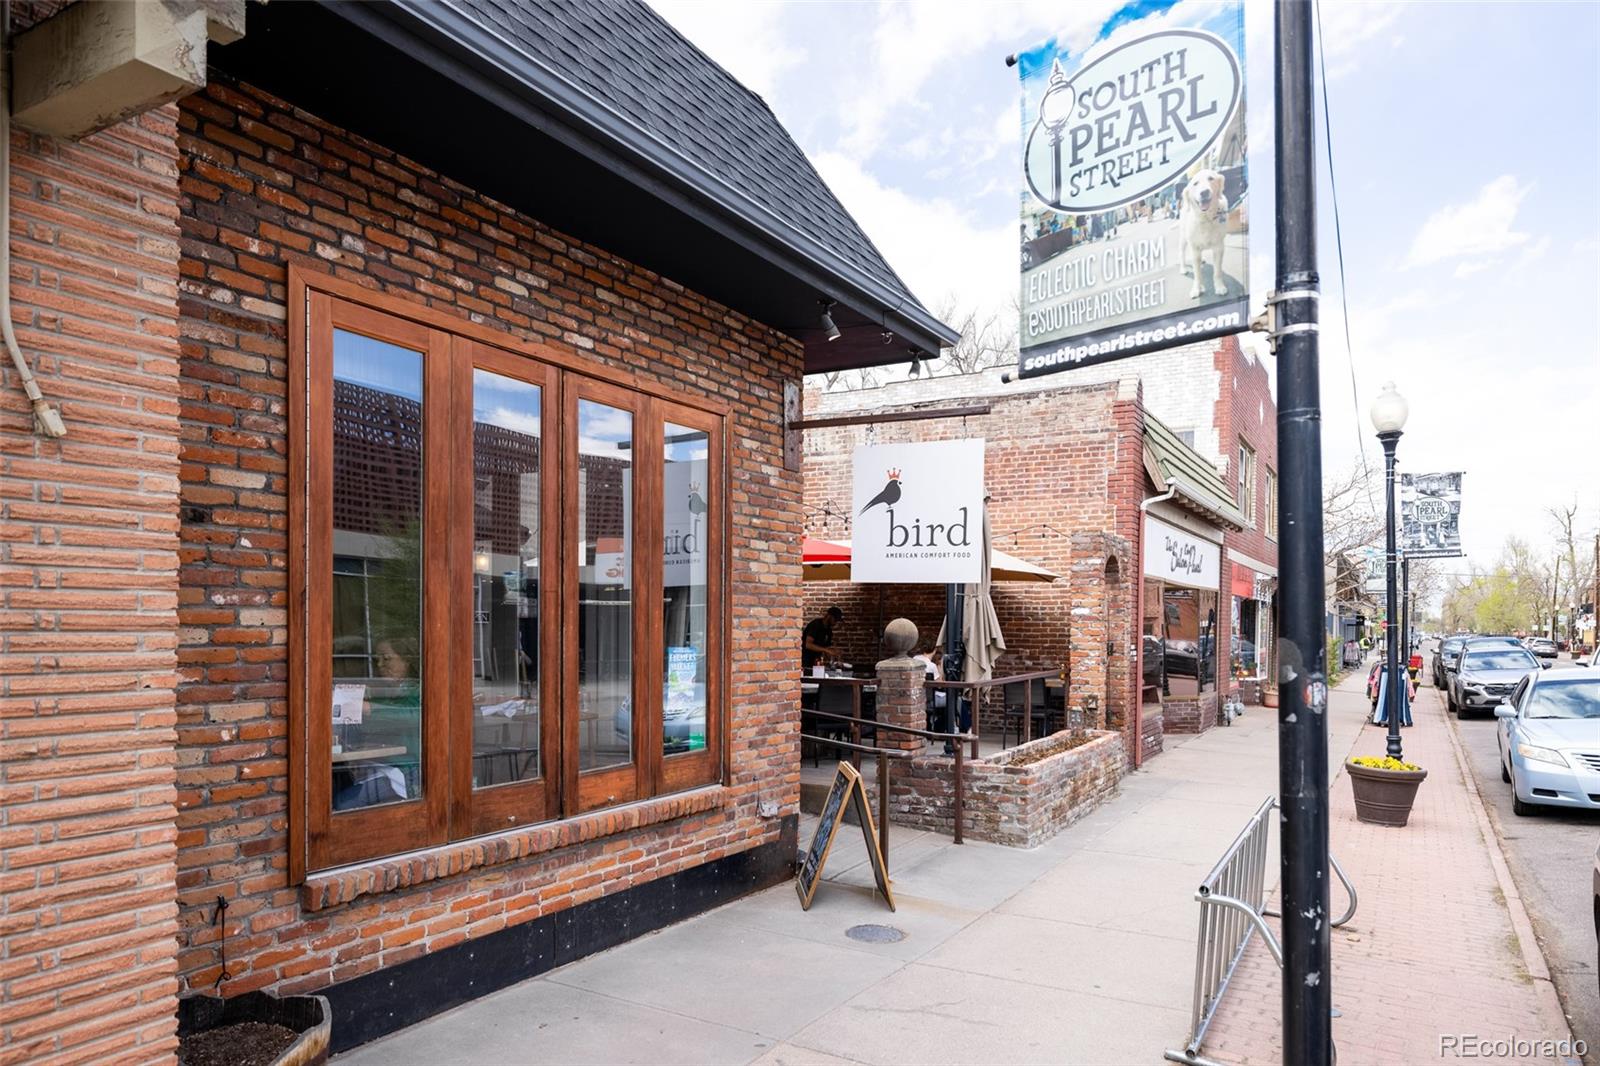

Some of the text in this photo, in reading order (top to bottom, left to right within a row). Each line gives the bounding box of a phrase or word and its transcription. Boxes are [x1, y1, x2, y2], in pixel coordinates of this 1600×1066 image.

[1077, 48, 1188, 119] SOUTH
[1069, 74, 1217, 168] PEARL
[1069, 137, 1174, 197] STREET
[1029, 236, 1165, 303] ECLECTIC CHARM
[1024, 311, 1240, 371] southpearlstreet.com
[886, 507, 971, 547] bird
[1420, 506, 1448, 517] PEARL
